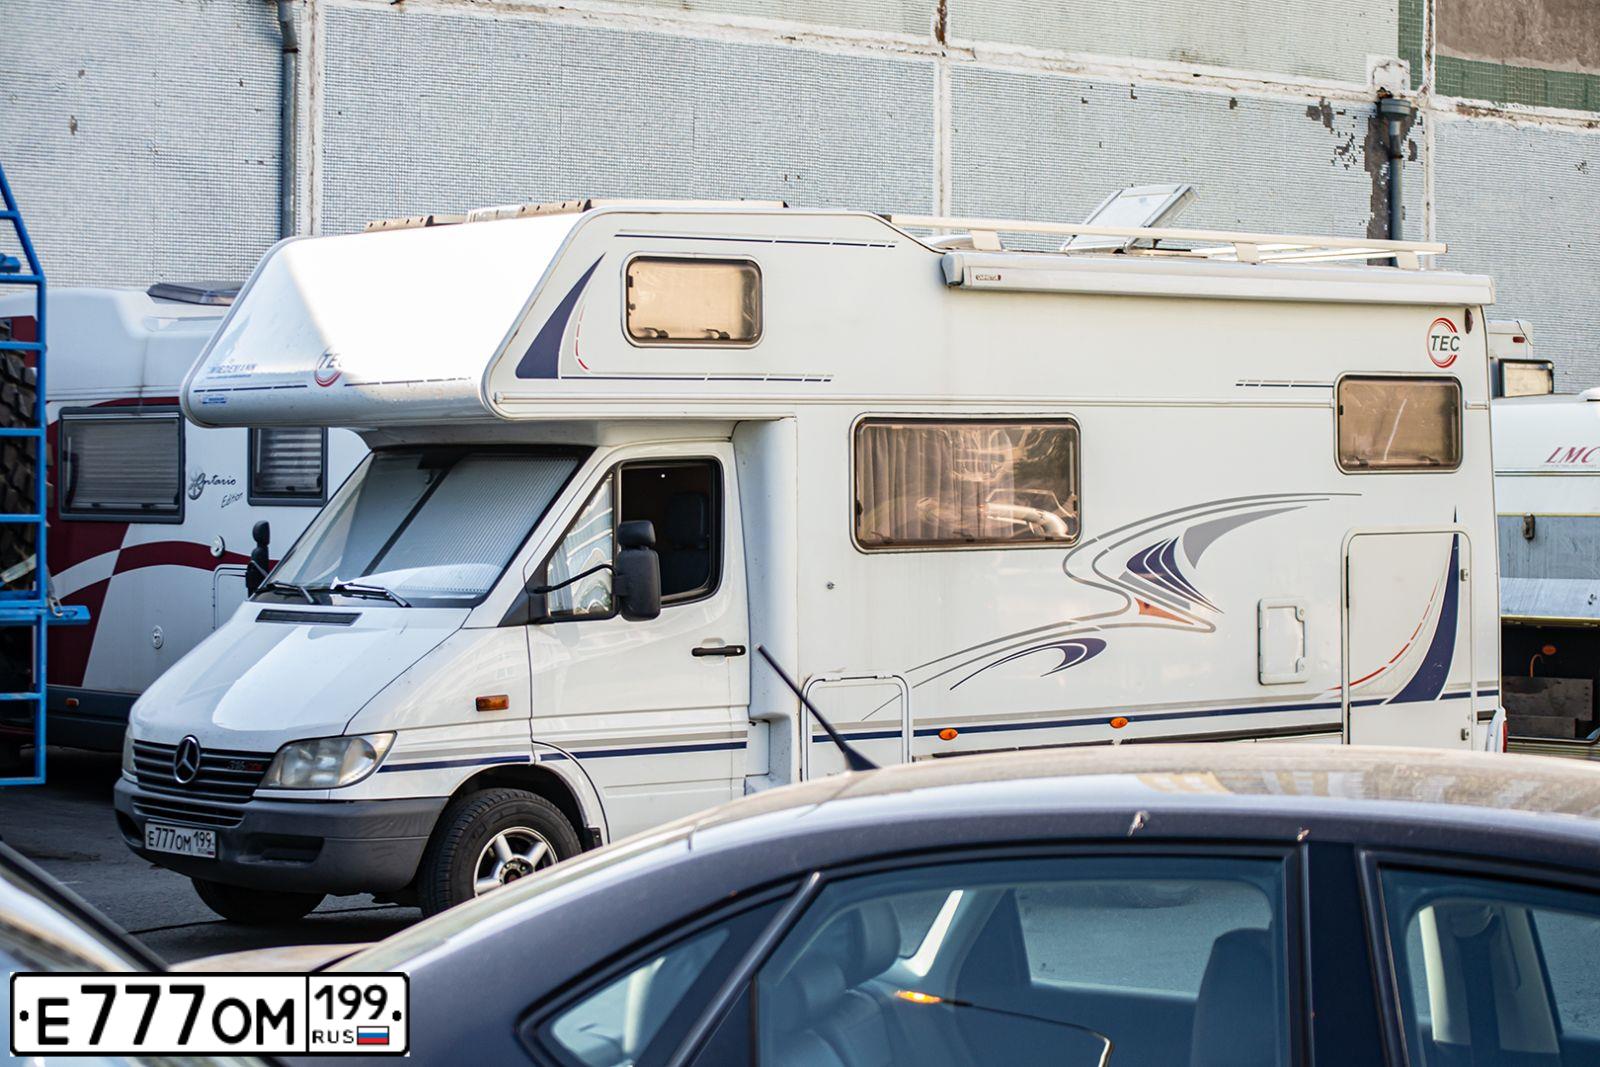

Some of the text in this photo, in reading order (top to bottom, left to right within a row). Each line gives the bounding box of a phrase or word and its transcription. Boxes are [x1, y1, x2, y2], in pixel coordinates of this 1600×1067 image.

[1431, 335, 1460, 351] TEC
[318, 353, 343, 370] TE
[1545, 446, 1600, 464] LMC
[193, 830, 212, 848] 199
